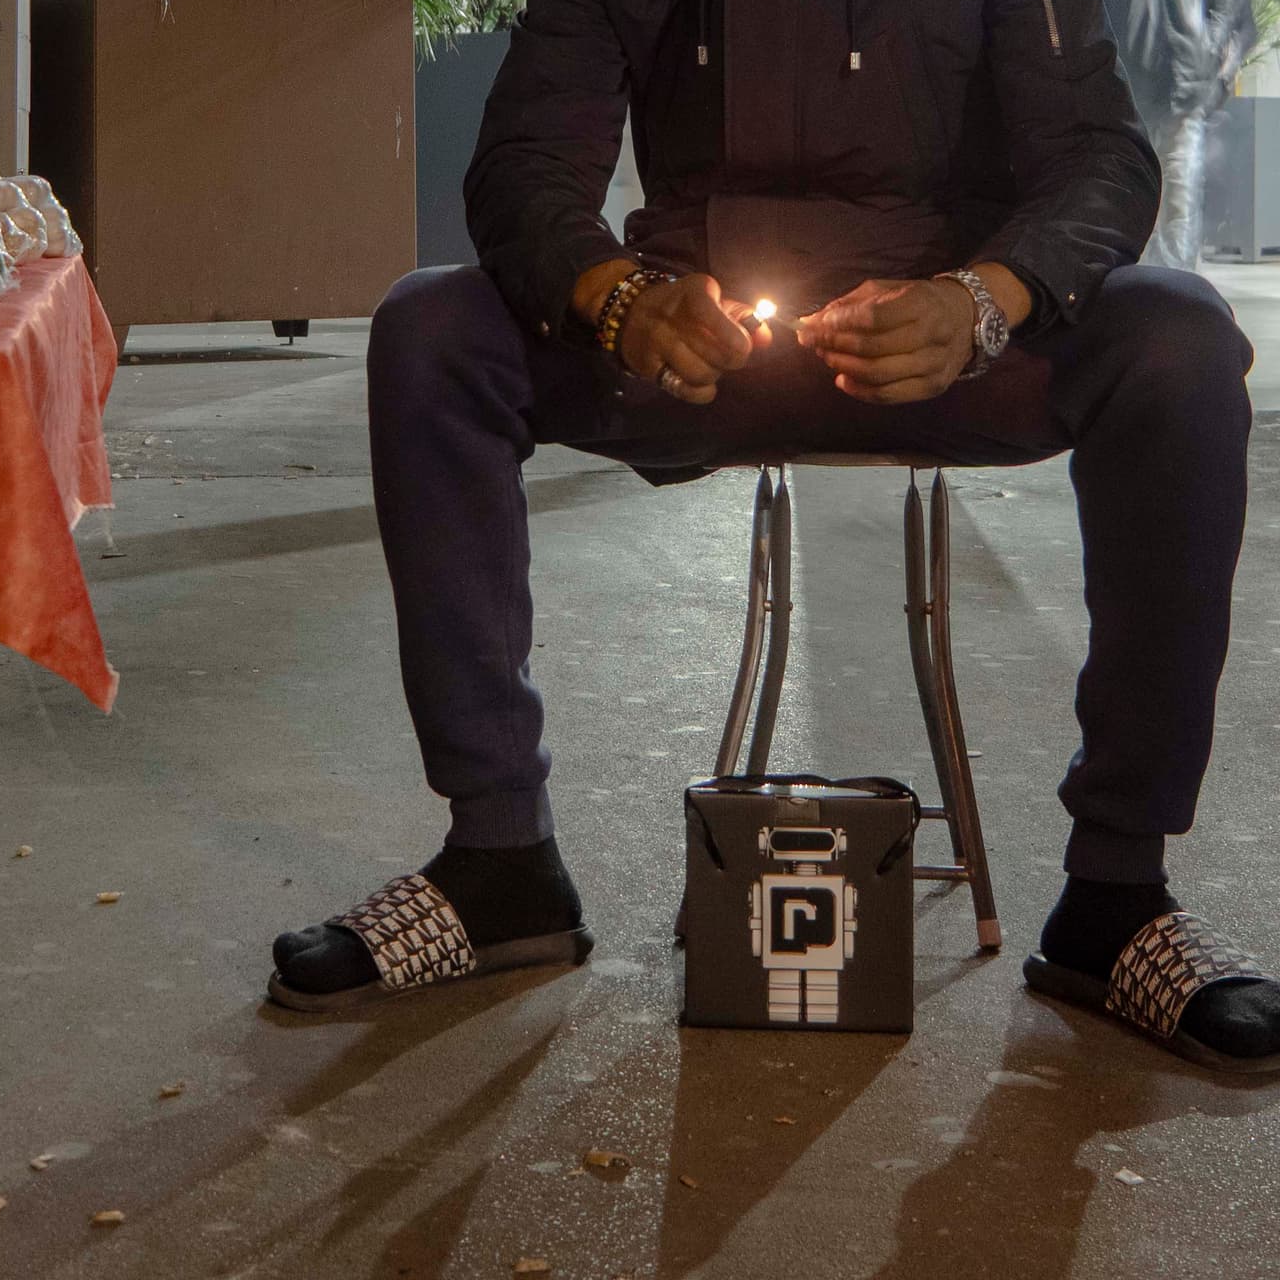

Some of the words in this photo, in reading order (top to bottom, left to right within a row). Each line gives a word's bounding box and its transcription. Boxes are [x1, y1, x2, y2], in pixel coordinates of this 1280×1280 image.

[1156, 916, 1175, 930] NIKE
[1144, 932, 1162, 954] NIKE
[1168, 932, 1186, 945] NIKE
[1157, 947, 1175, 966] NIKE
[1169, 962, 1189, 981] NIKE
[1181, 976, 1201, 995] NIKE
